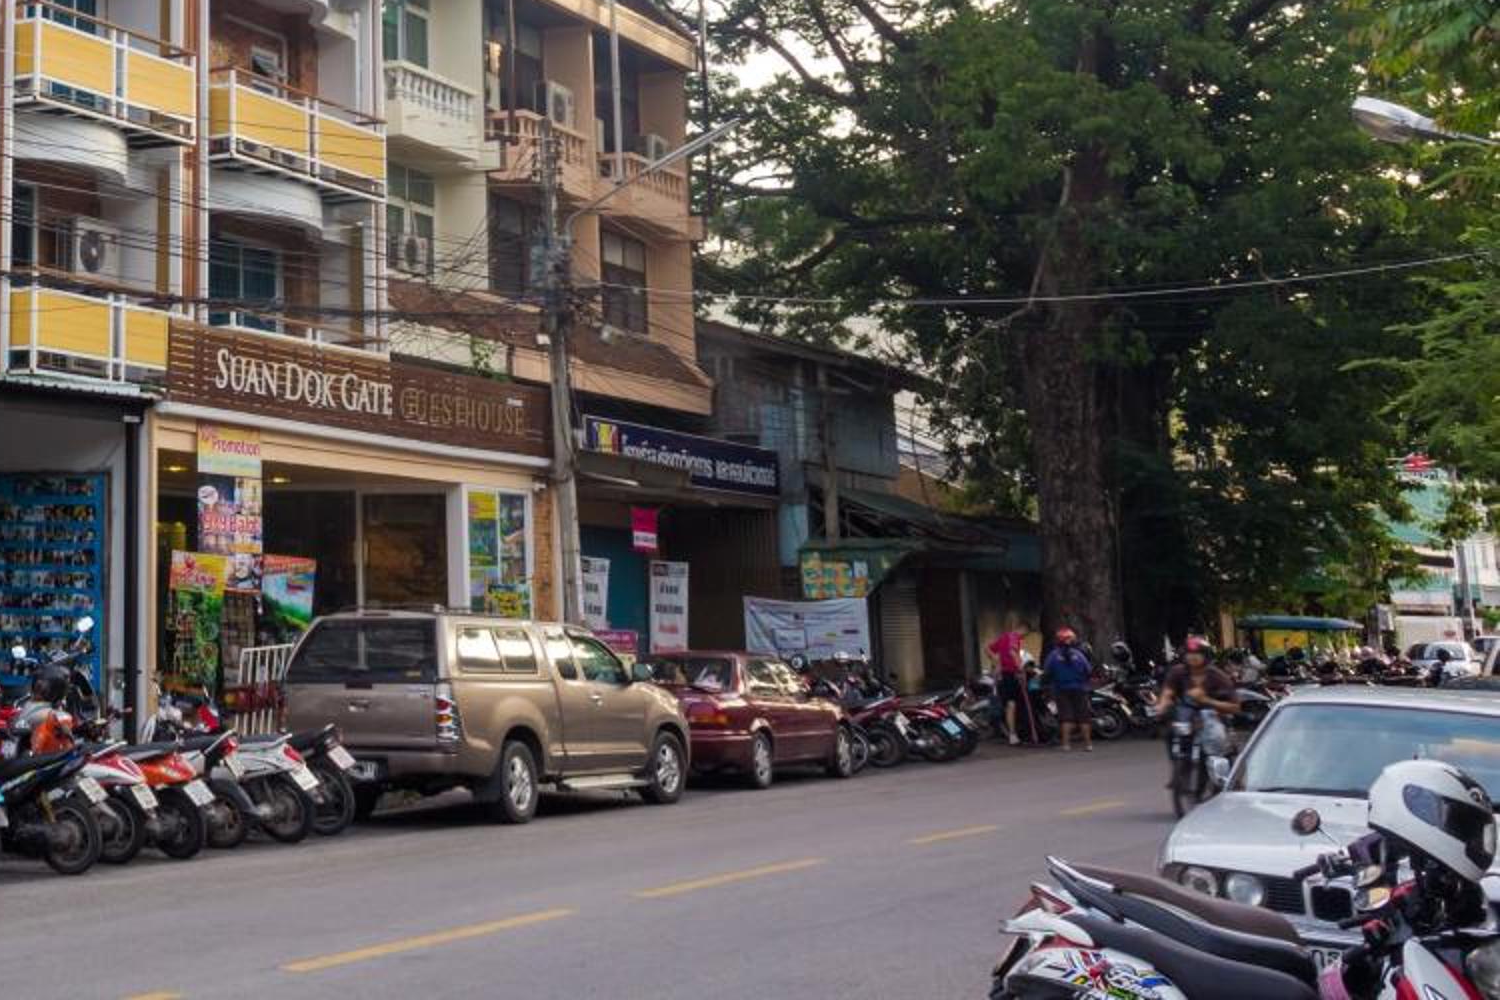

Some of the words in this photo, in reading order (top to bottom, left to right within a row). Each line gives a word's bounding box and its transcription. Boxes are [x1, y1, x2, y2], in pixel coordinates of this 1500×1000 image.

[215, 349, 278, 398] SUAN
[284, 361, 337, 409] DOK
[341, 373, 393, 417] GATE
